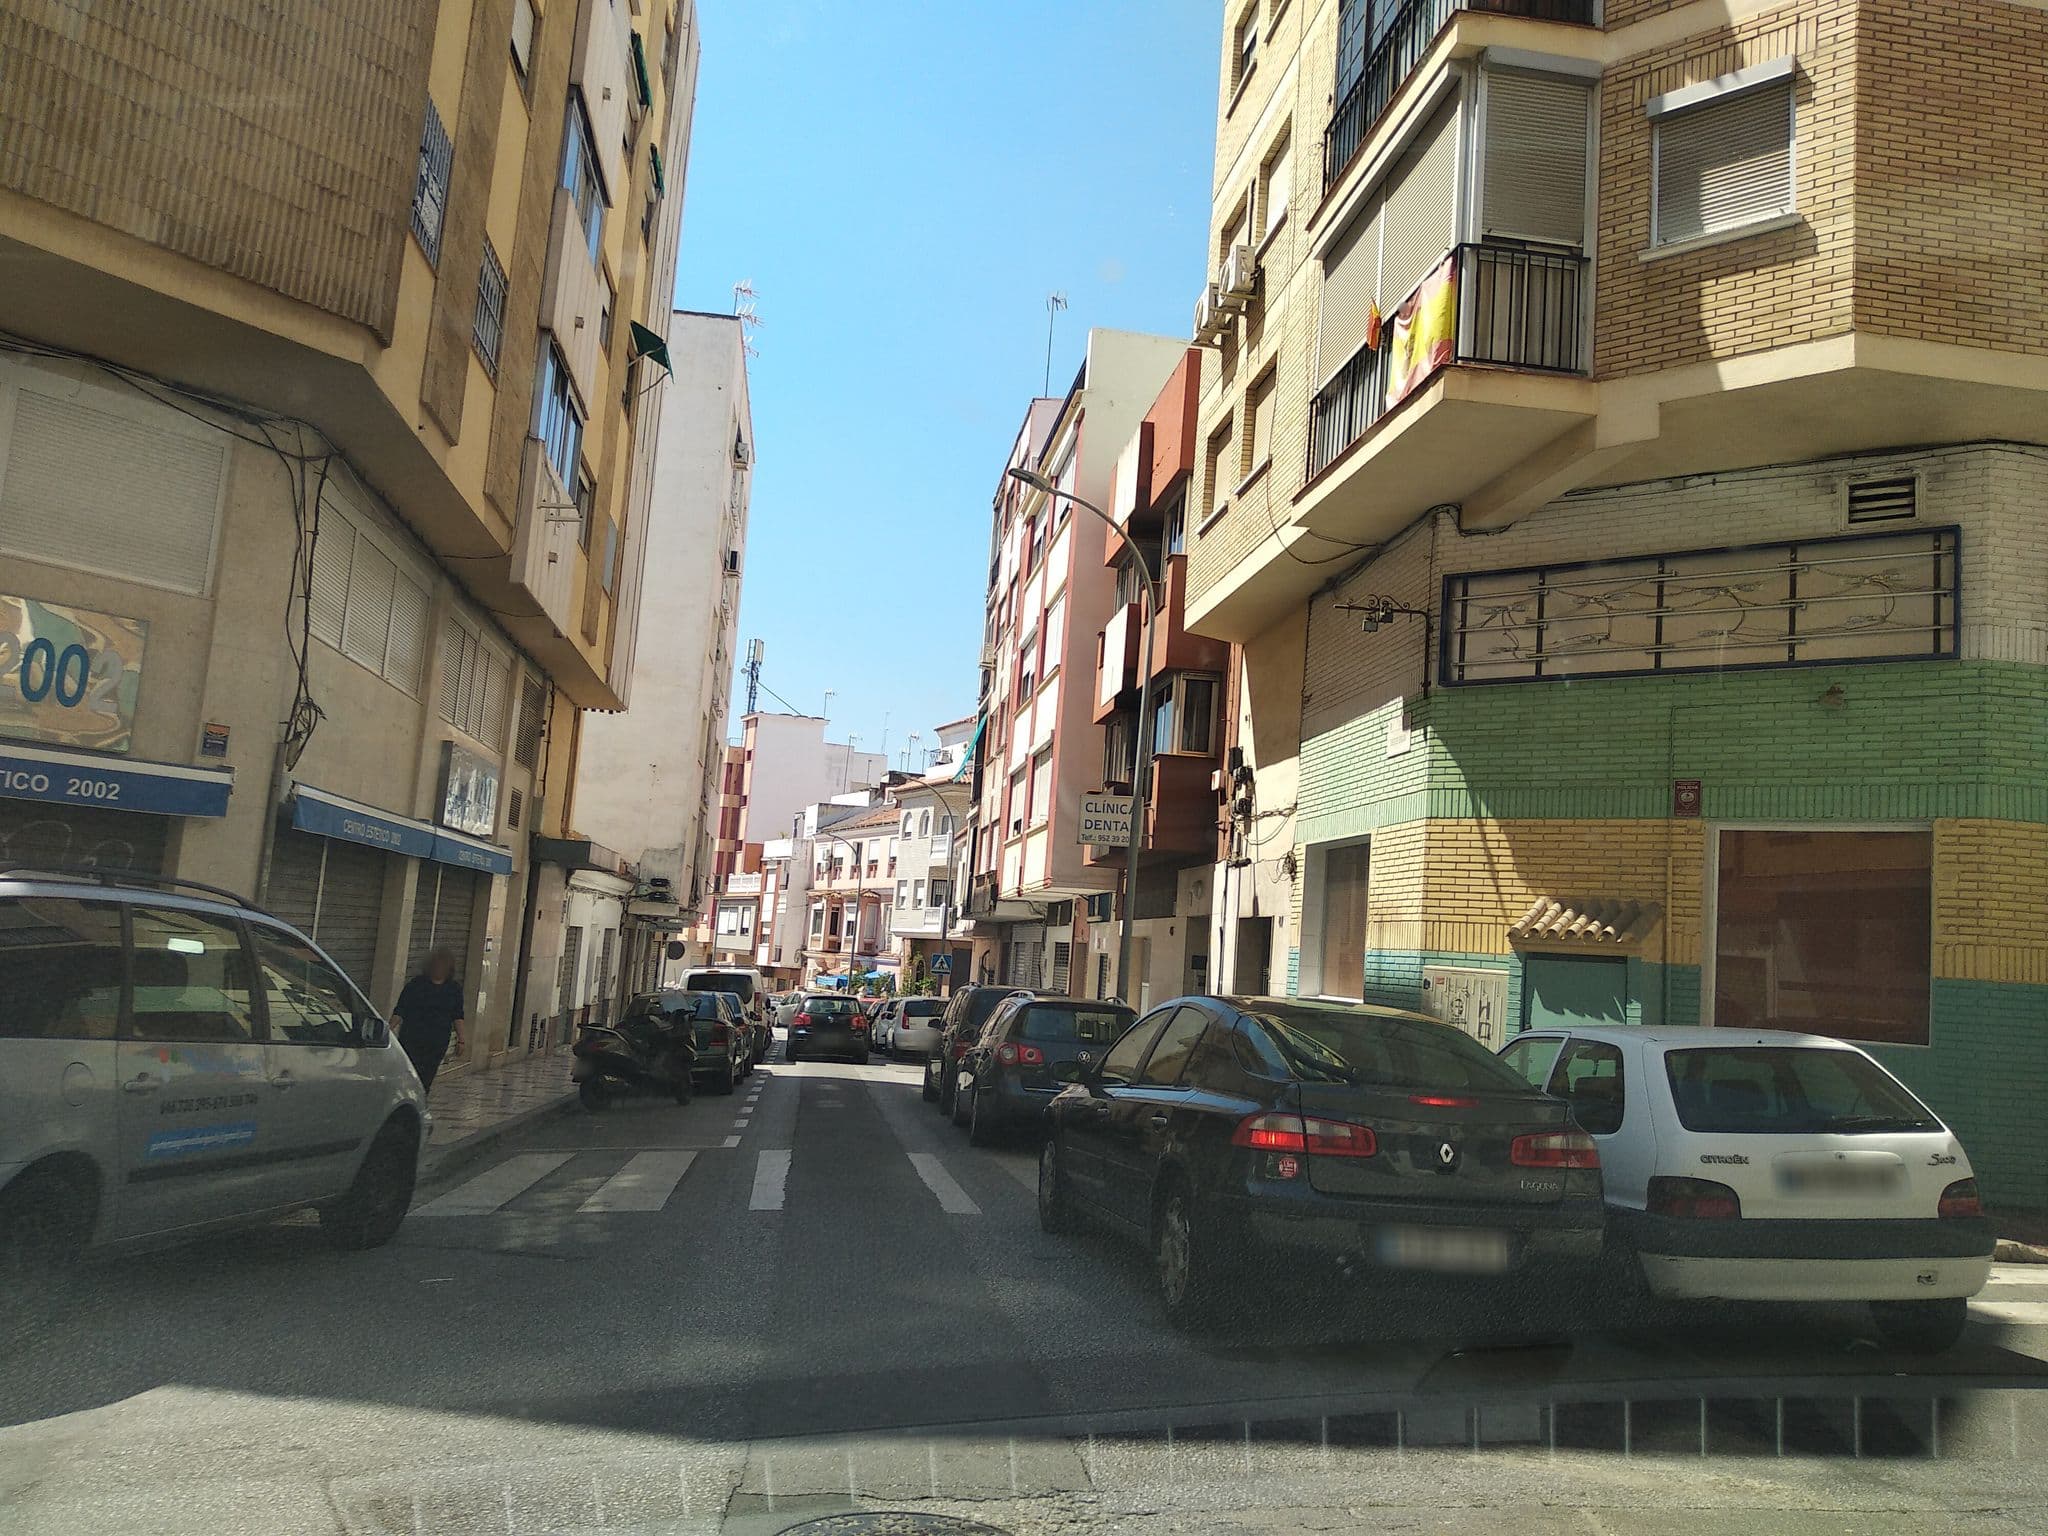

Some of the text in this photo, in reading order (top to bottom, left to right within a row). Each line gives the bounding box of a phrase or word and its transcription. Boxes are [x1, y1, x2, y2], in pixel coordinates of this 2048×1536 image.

[66, 778, 121, 801] 2002
[1084, 819, 1129, 832] DENTA
[1700, 1154, 1750, 1165] CITROËN
